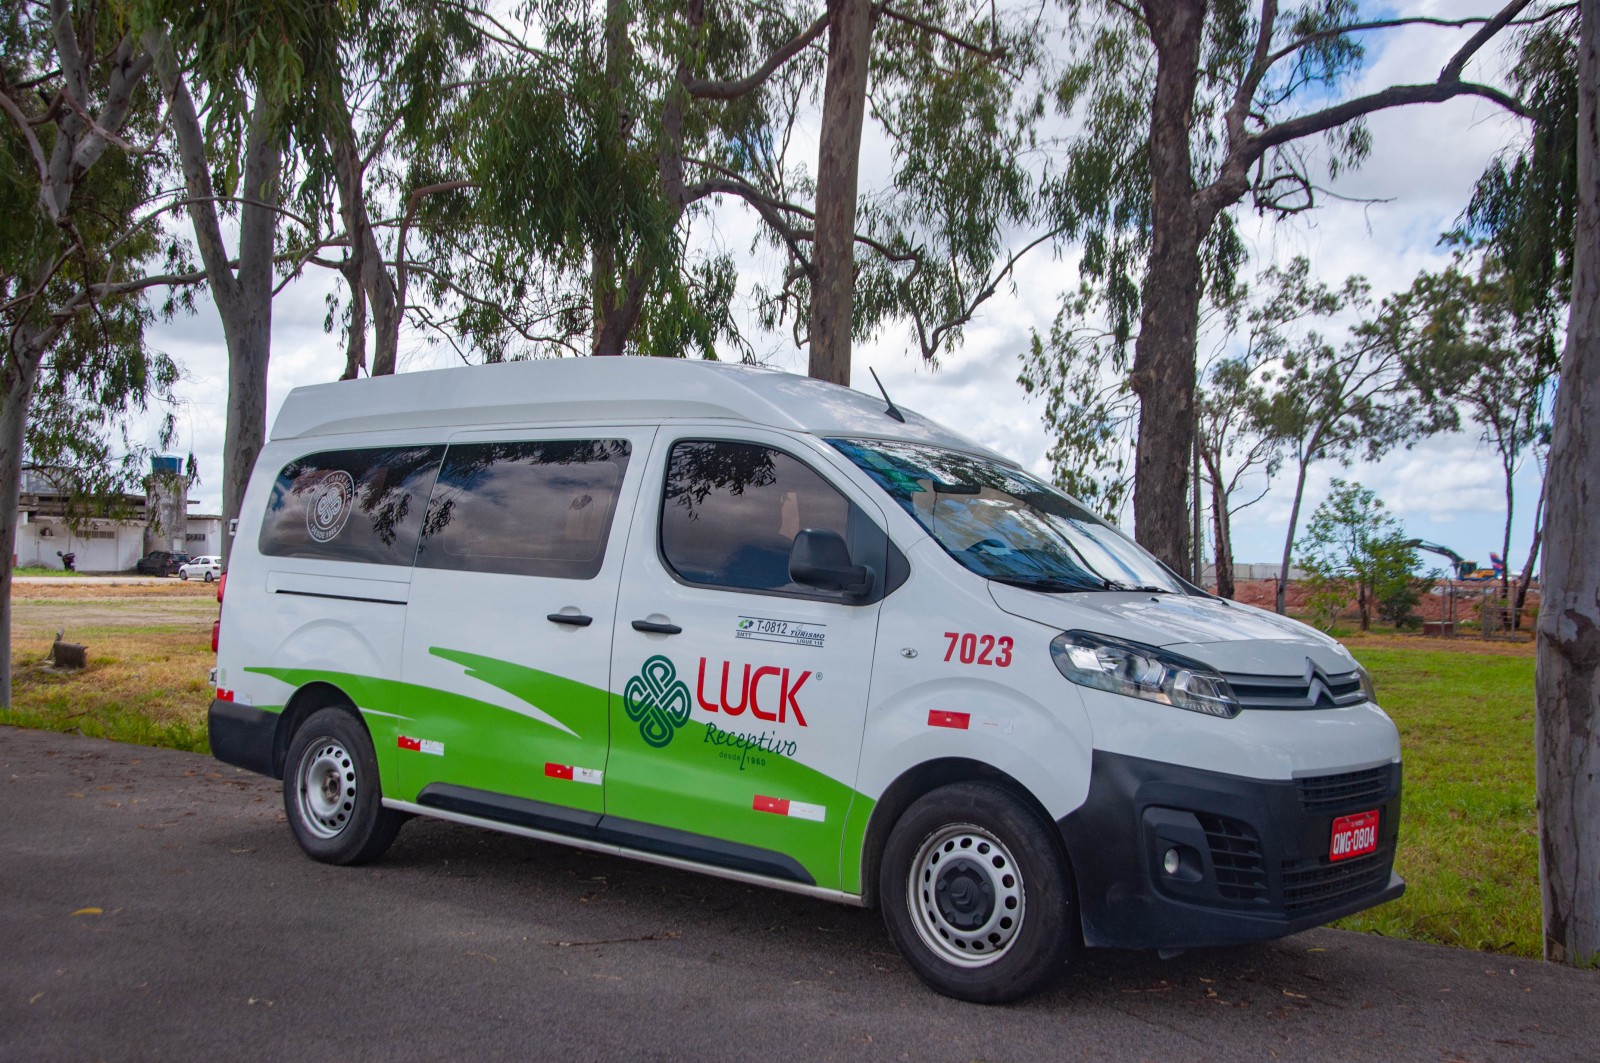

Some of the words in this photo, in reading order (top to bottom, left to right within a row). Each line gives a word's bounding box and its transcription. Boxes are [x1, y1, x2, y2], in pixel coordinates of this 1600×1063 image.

[757, 620, 788, 634] T-0812
[790, 630, 825, 639] TURISMO
[943, 631, 1014, 668] 7023
[696, 656, 813, 727] LUCK
[703, 721, 797, 770] Receptivo
[719, 751, 740, 761] desde
[746, 756, 766, 766] 1960
